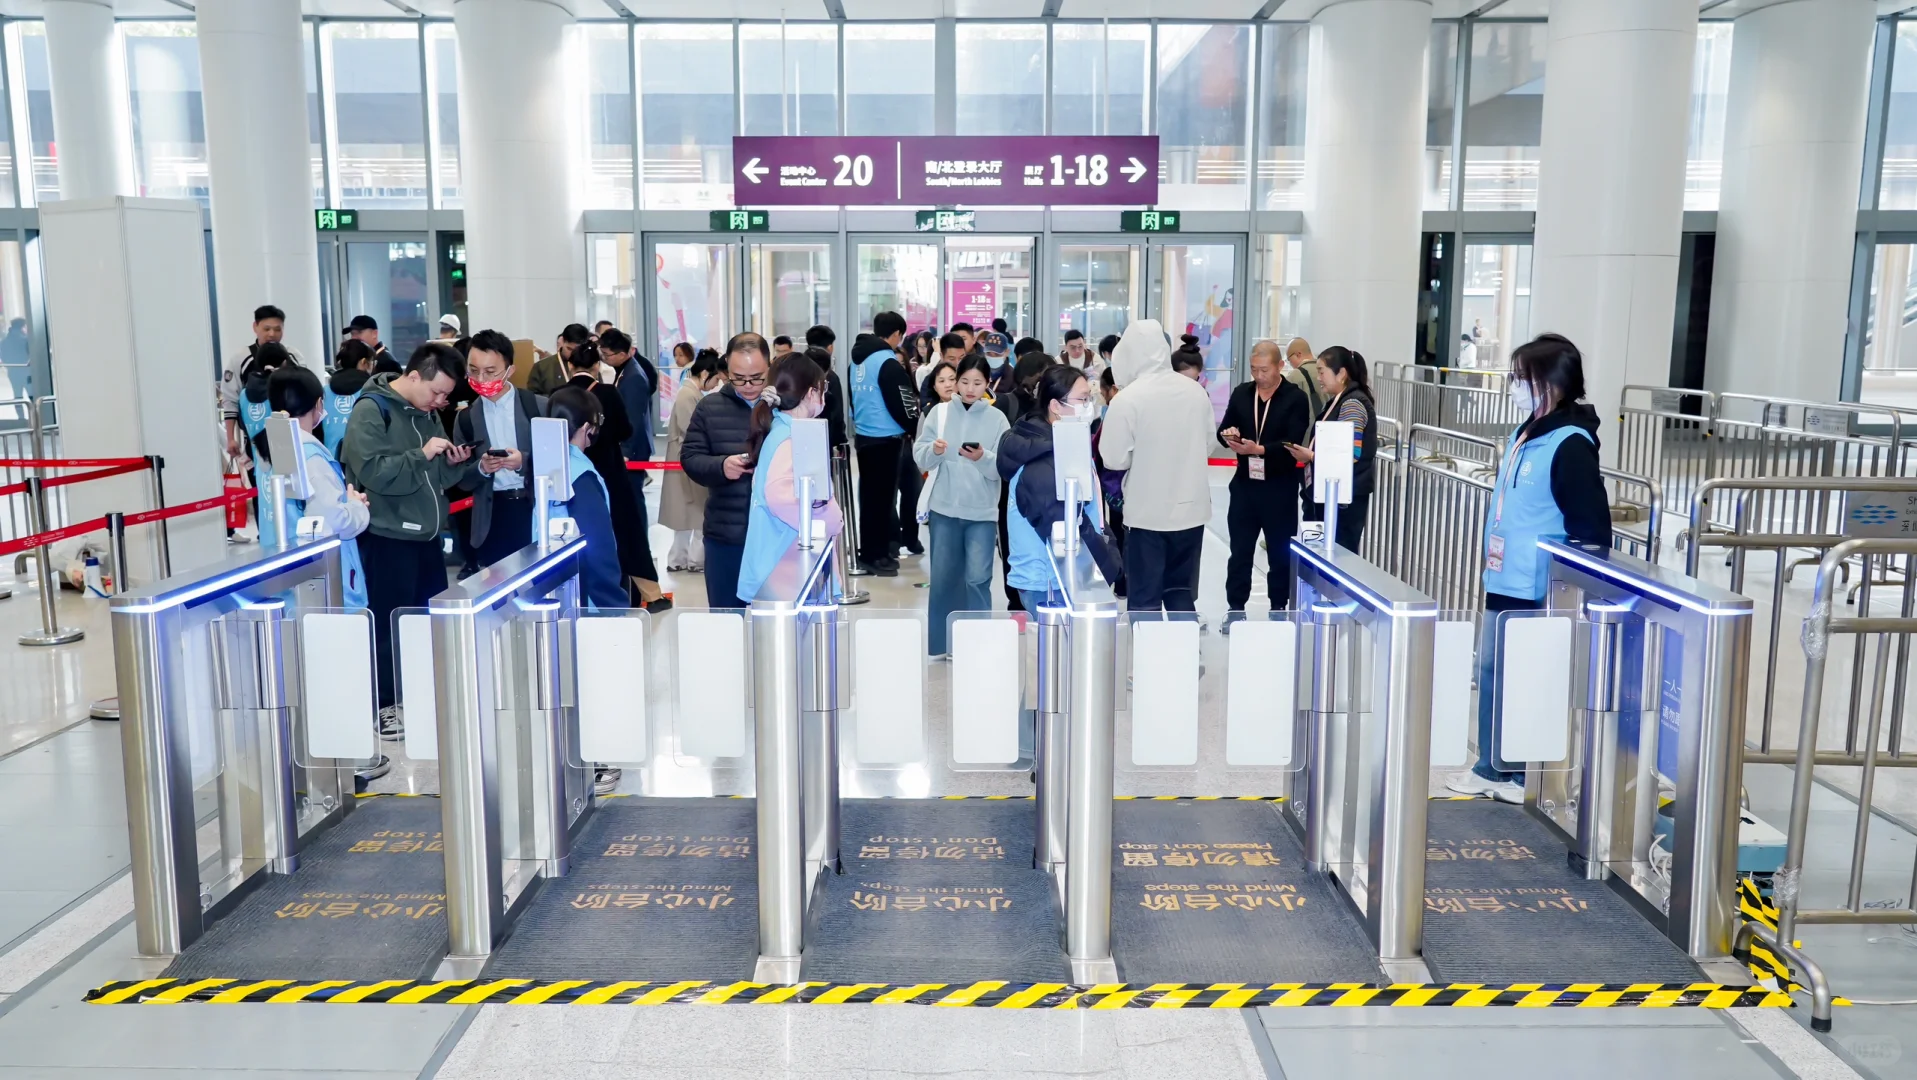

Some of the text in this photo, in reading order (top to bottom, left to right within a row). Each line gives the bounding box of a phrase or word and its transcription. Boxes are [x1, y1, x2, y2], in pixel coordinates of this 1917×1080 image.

[833, 155, 873, 186] 20
[925, 160, 1003, 175] 南/北登录大厅
[1050, 154, 1109, 186] 1-18
[780, 177, 828, 186] Event Center
[925, 176, 1002, 187] South/North Lobbies
[1024, 176, 1044, 186] Halls
[373, 830, 427, 839] stop
[622, 834, 749, 844] Don't stop
[869, 835, 997, 845] Don't stop
[602, 843, 751, 858] 请勿停留
[1118, 842, 1273, 851] Please don't stop
[858, 846, 1005, 860] 请勿停留
[1121, 851, 1281, 867] 请勿停留
[588, 883, 640, 891] steps
[860, 882, 910, 893] steps
[1144, 882, 1297, 893] Mind the steps
[302, 892, 352, 900] steps
[570, 893, 735, 910] 小心台阶
[850, 891, 1013, 912] 小心台阶
[1139, 893, 1307, 911] 小心台阶
[274, 902, 445, 919] 小心台阶
